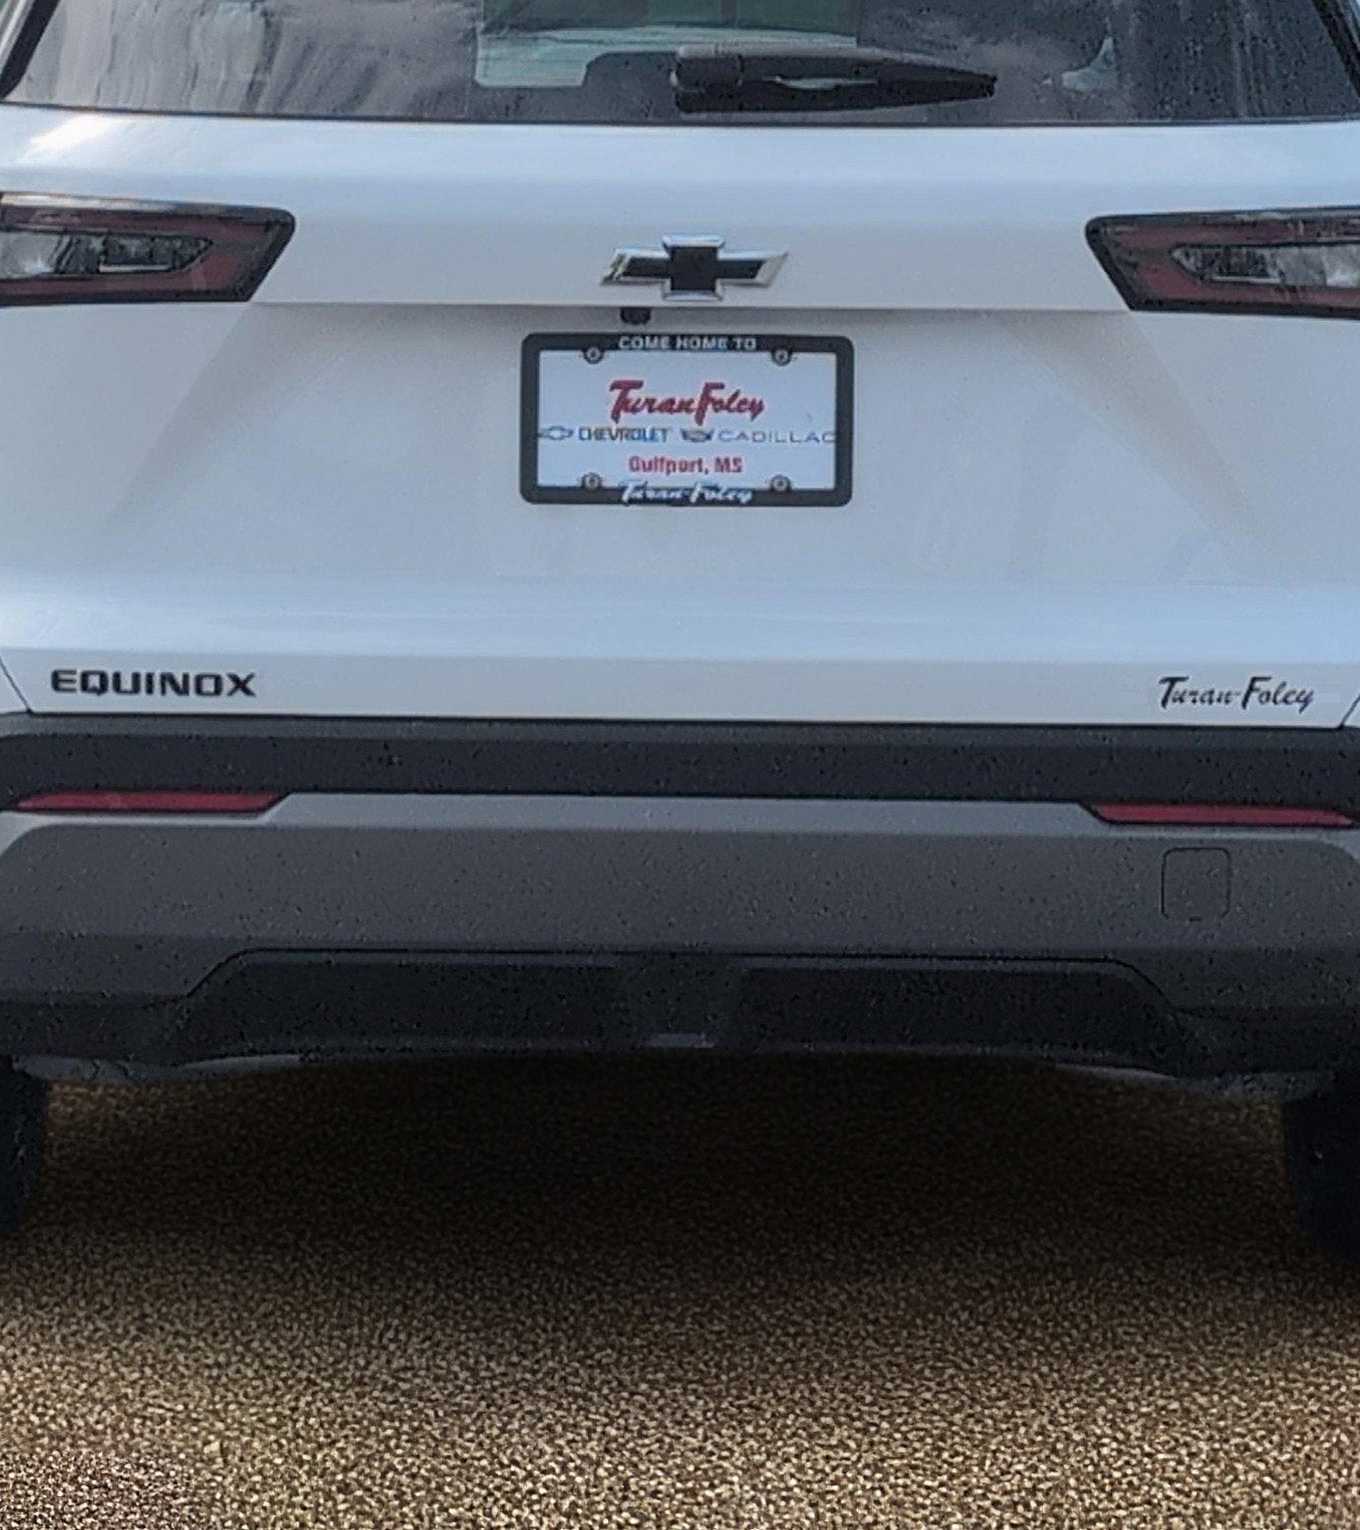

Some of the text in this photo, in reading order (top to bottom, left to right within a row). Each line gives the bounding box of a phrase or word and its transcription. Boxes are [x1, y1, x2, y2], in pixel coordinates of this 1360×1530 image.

[618, 336, 757, 350] COME HOME TO
[578, 427, 837, 444] CHEVROLET CADILLAC
[628, 455, 744, 475] Gulfport, MS
[50, 669, 257, 697] EQUINOX
[1241, 675, 1314, 714] Foley
